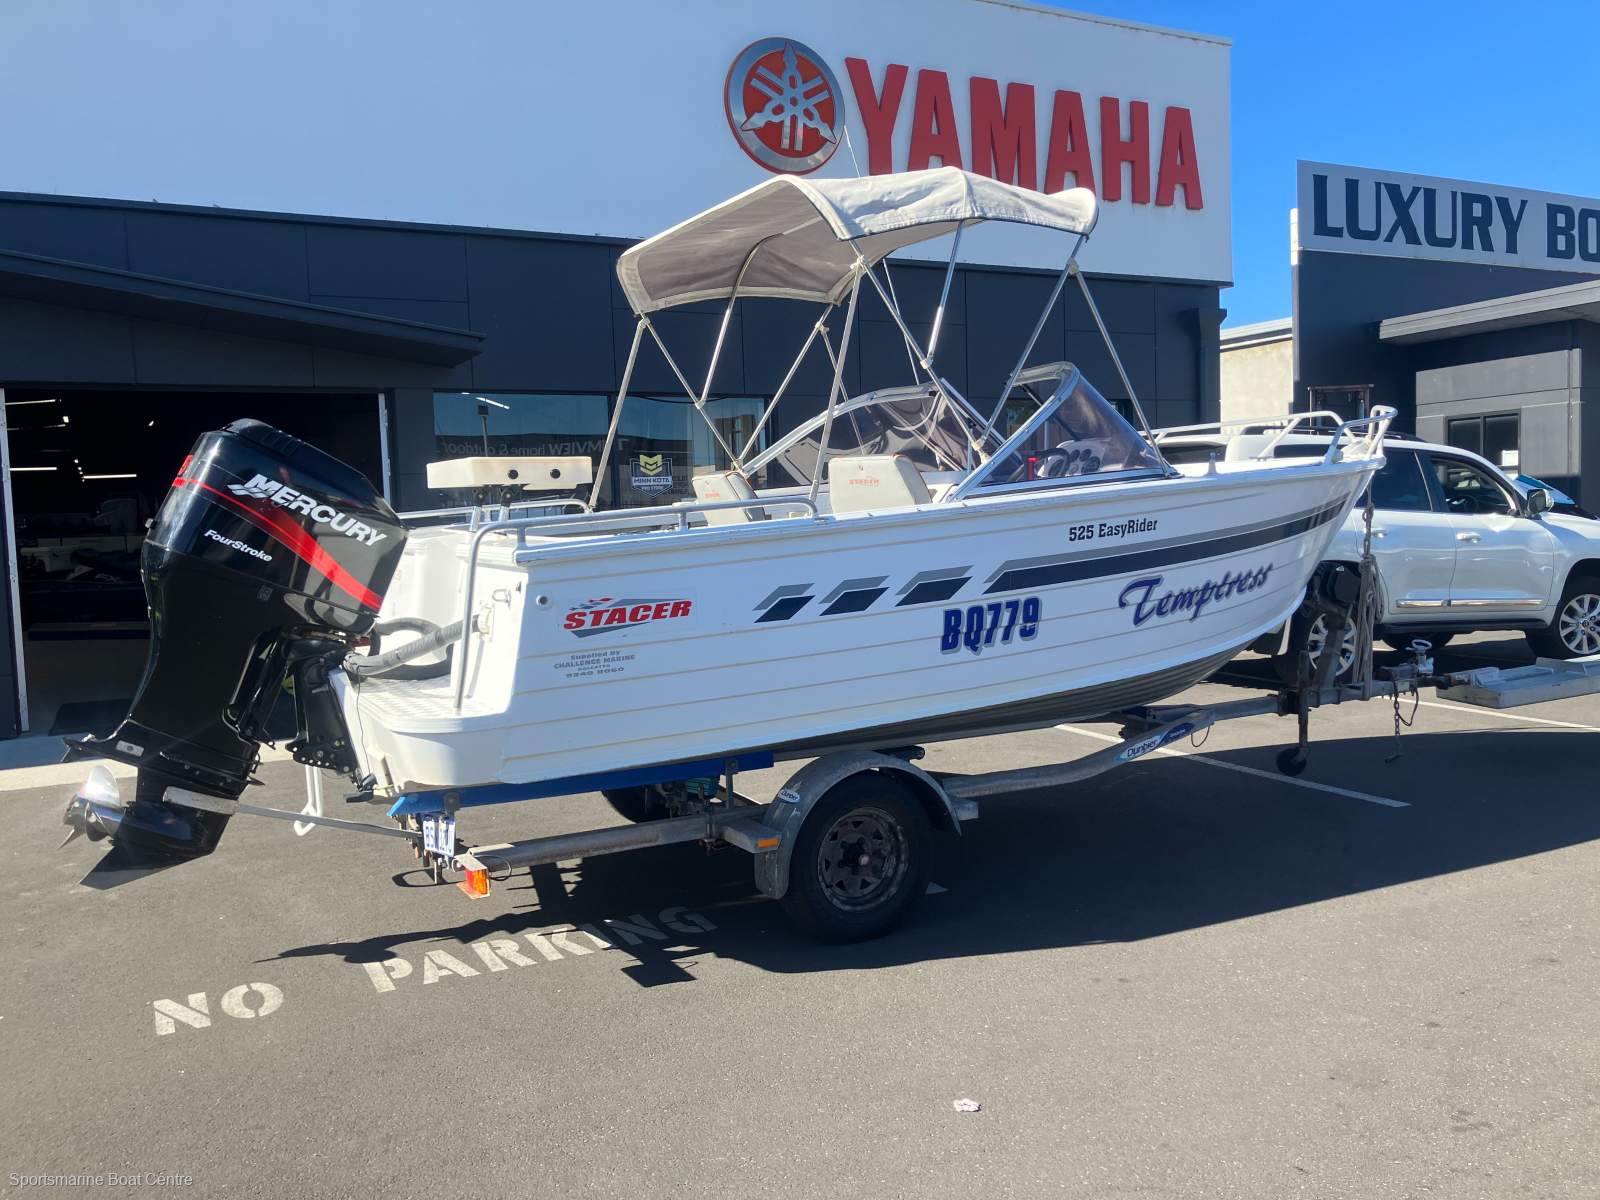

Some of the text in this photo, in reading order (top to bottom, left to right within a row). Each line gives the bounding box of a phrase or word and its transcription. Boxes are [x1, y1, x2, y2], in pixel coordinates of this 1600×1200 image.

[844, 56, 1203, 210] YAMAHA
[1312, 173, 1528, 254] LUXURY
[243, 473, 388, 547] MERCURY
[1069, 518, 1158, 541] 525 EasyRider
[204, 529, 272, 562] FourStroke
[563, 600, 692, 630] STACER
[1118, 562, 1274, 627] Temptress
[940, 597, 1042, 655] BQ779
[1127, 739, 1158, 757] Dunbier
[153, 905, 719, 1035] NO PARKING
